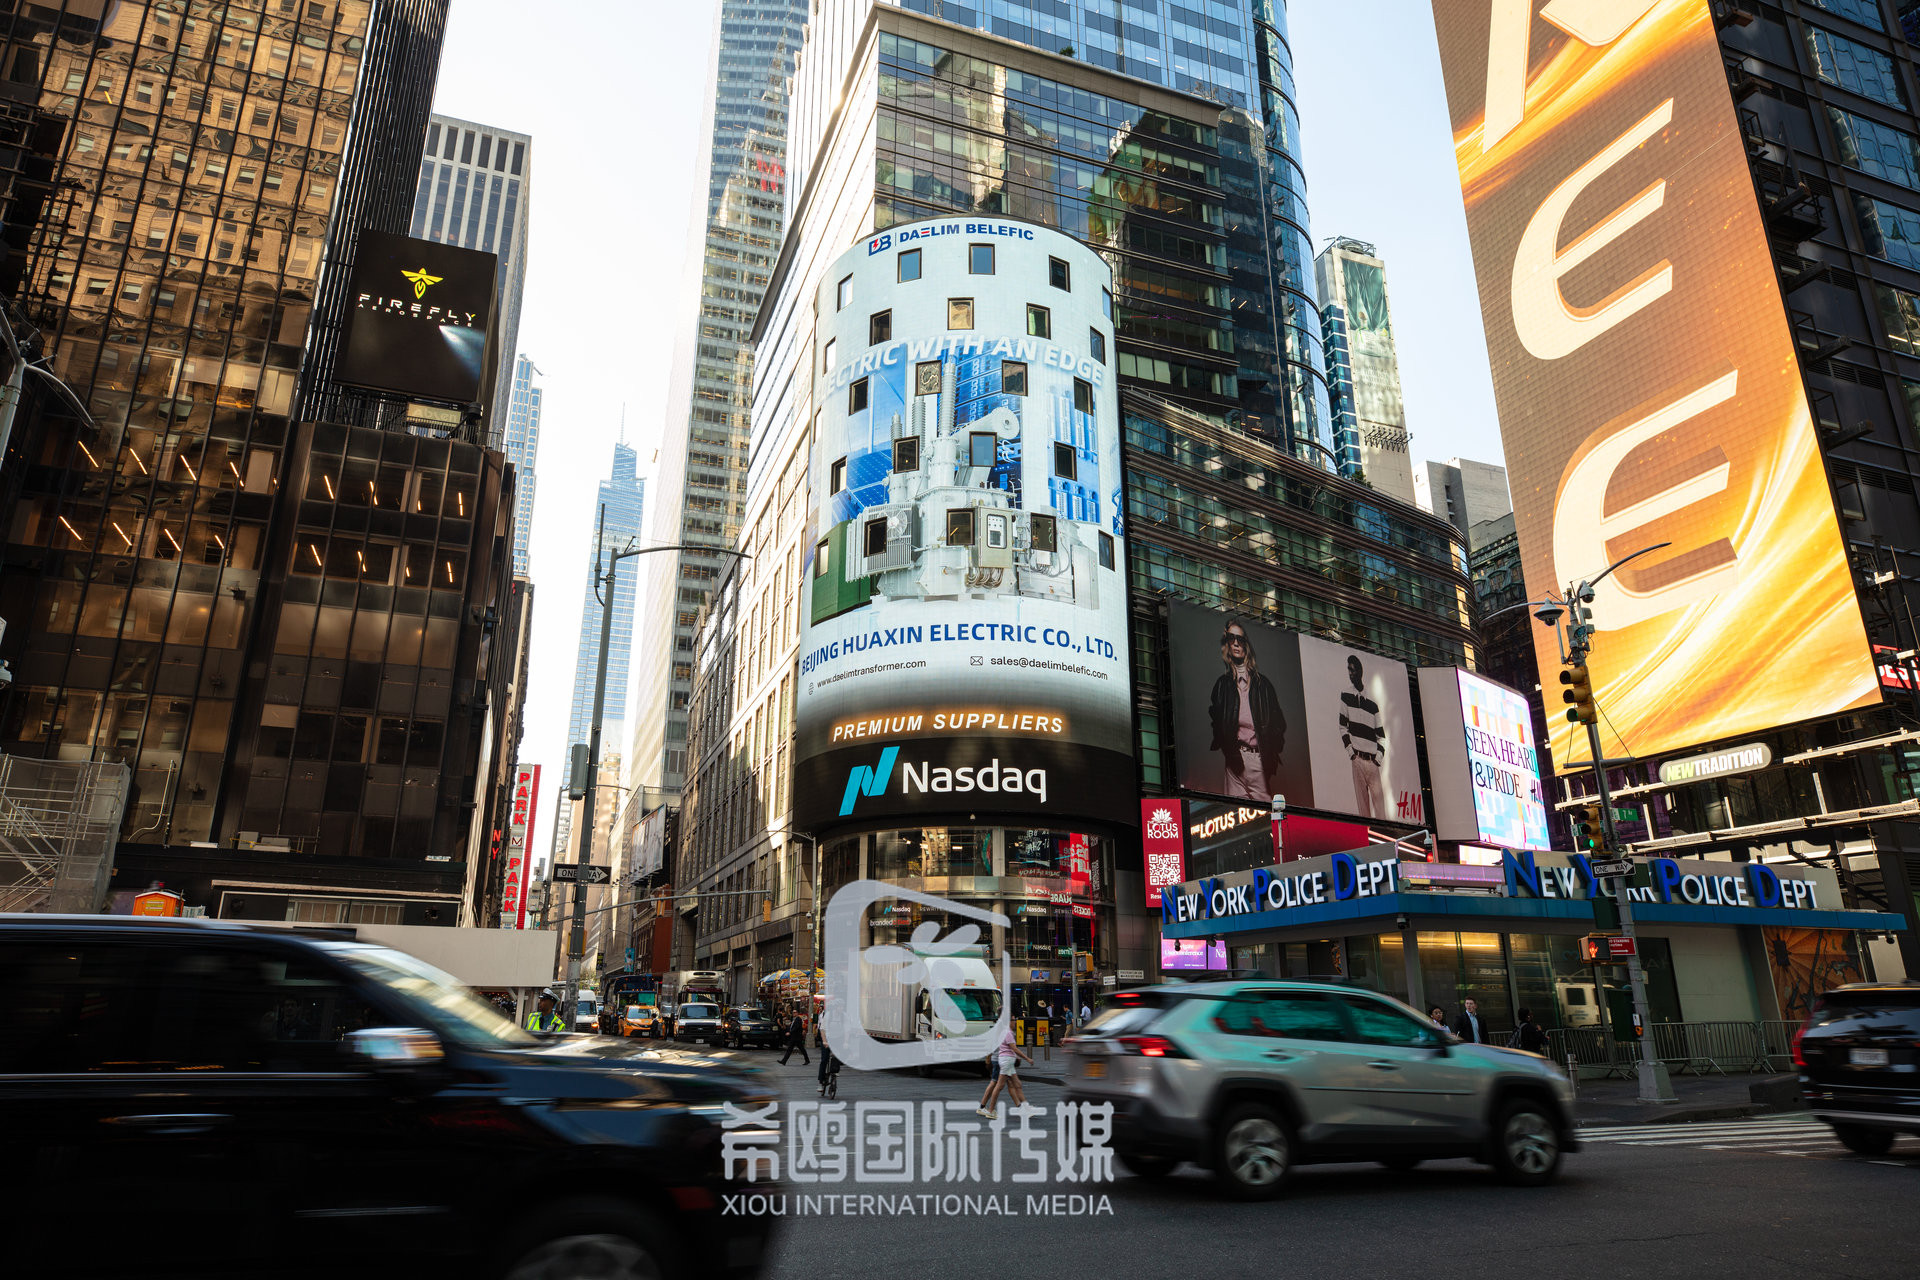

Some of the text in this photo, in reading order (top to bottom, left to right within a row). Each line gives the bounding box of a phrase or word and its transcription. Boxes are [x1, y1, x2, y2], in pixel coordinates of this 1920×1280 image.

[899, 224, 960, 243] DAELIM
[965, 223, 1034, 241] BELEFIC
[358, 303, 472, 328] AEROSPACE
[359, 293, 476, 321] FIREFLY
[907, 335, 985, 361] WITH
[991, 335, 1036, 362] AN
[1045, 343, 1105, 387] EDGE
[801, 623, 1118, 676] BEIJING HUAXIN ELECTRIC CO., LTD.
[817, 659, 926, 688] www.daelimtransformer.com
[990, 656, 1108, 680] sales@daelimbelefic.com
[832, 712, 1063, 743] PREMIUM SUPPLIERS
[902, 758, 1047, 804] Nasdaq
[513, 772, 531, 825] PARK
[1396, 790, 1422, 822] H&M
[1147, 823, 1178, 832] LOTUS
[1147, 831, 1179, 839] ROOM
[1199, 811, 1235, 839] LOTUS
[561, 869, 578, 878] ONE
[1502, 848, 1576, 899] NEW
[1654, 858, 1750, 907] POLICE
[1749, 863, 1817, 909] DEPT
[1595, 863, 1628, 873] ONE WAY
[503, 857, 521, 912] PARK
[1161, 852, 1398, 924] NEW YORK POLICE DEPT
[892, 906, 911, 914] Nasdaq
[1026, 906, 1047, 914] Nasdaq
